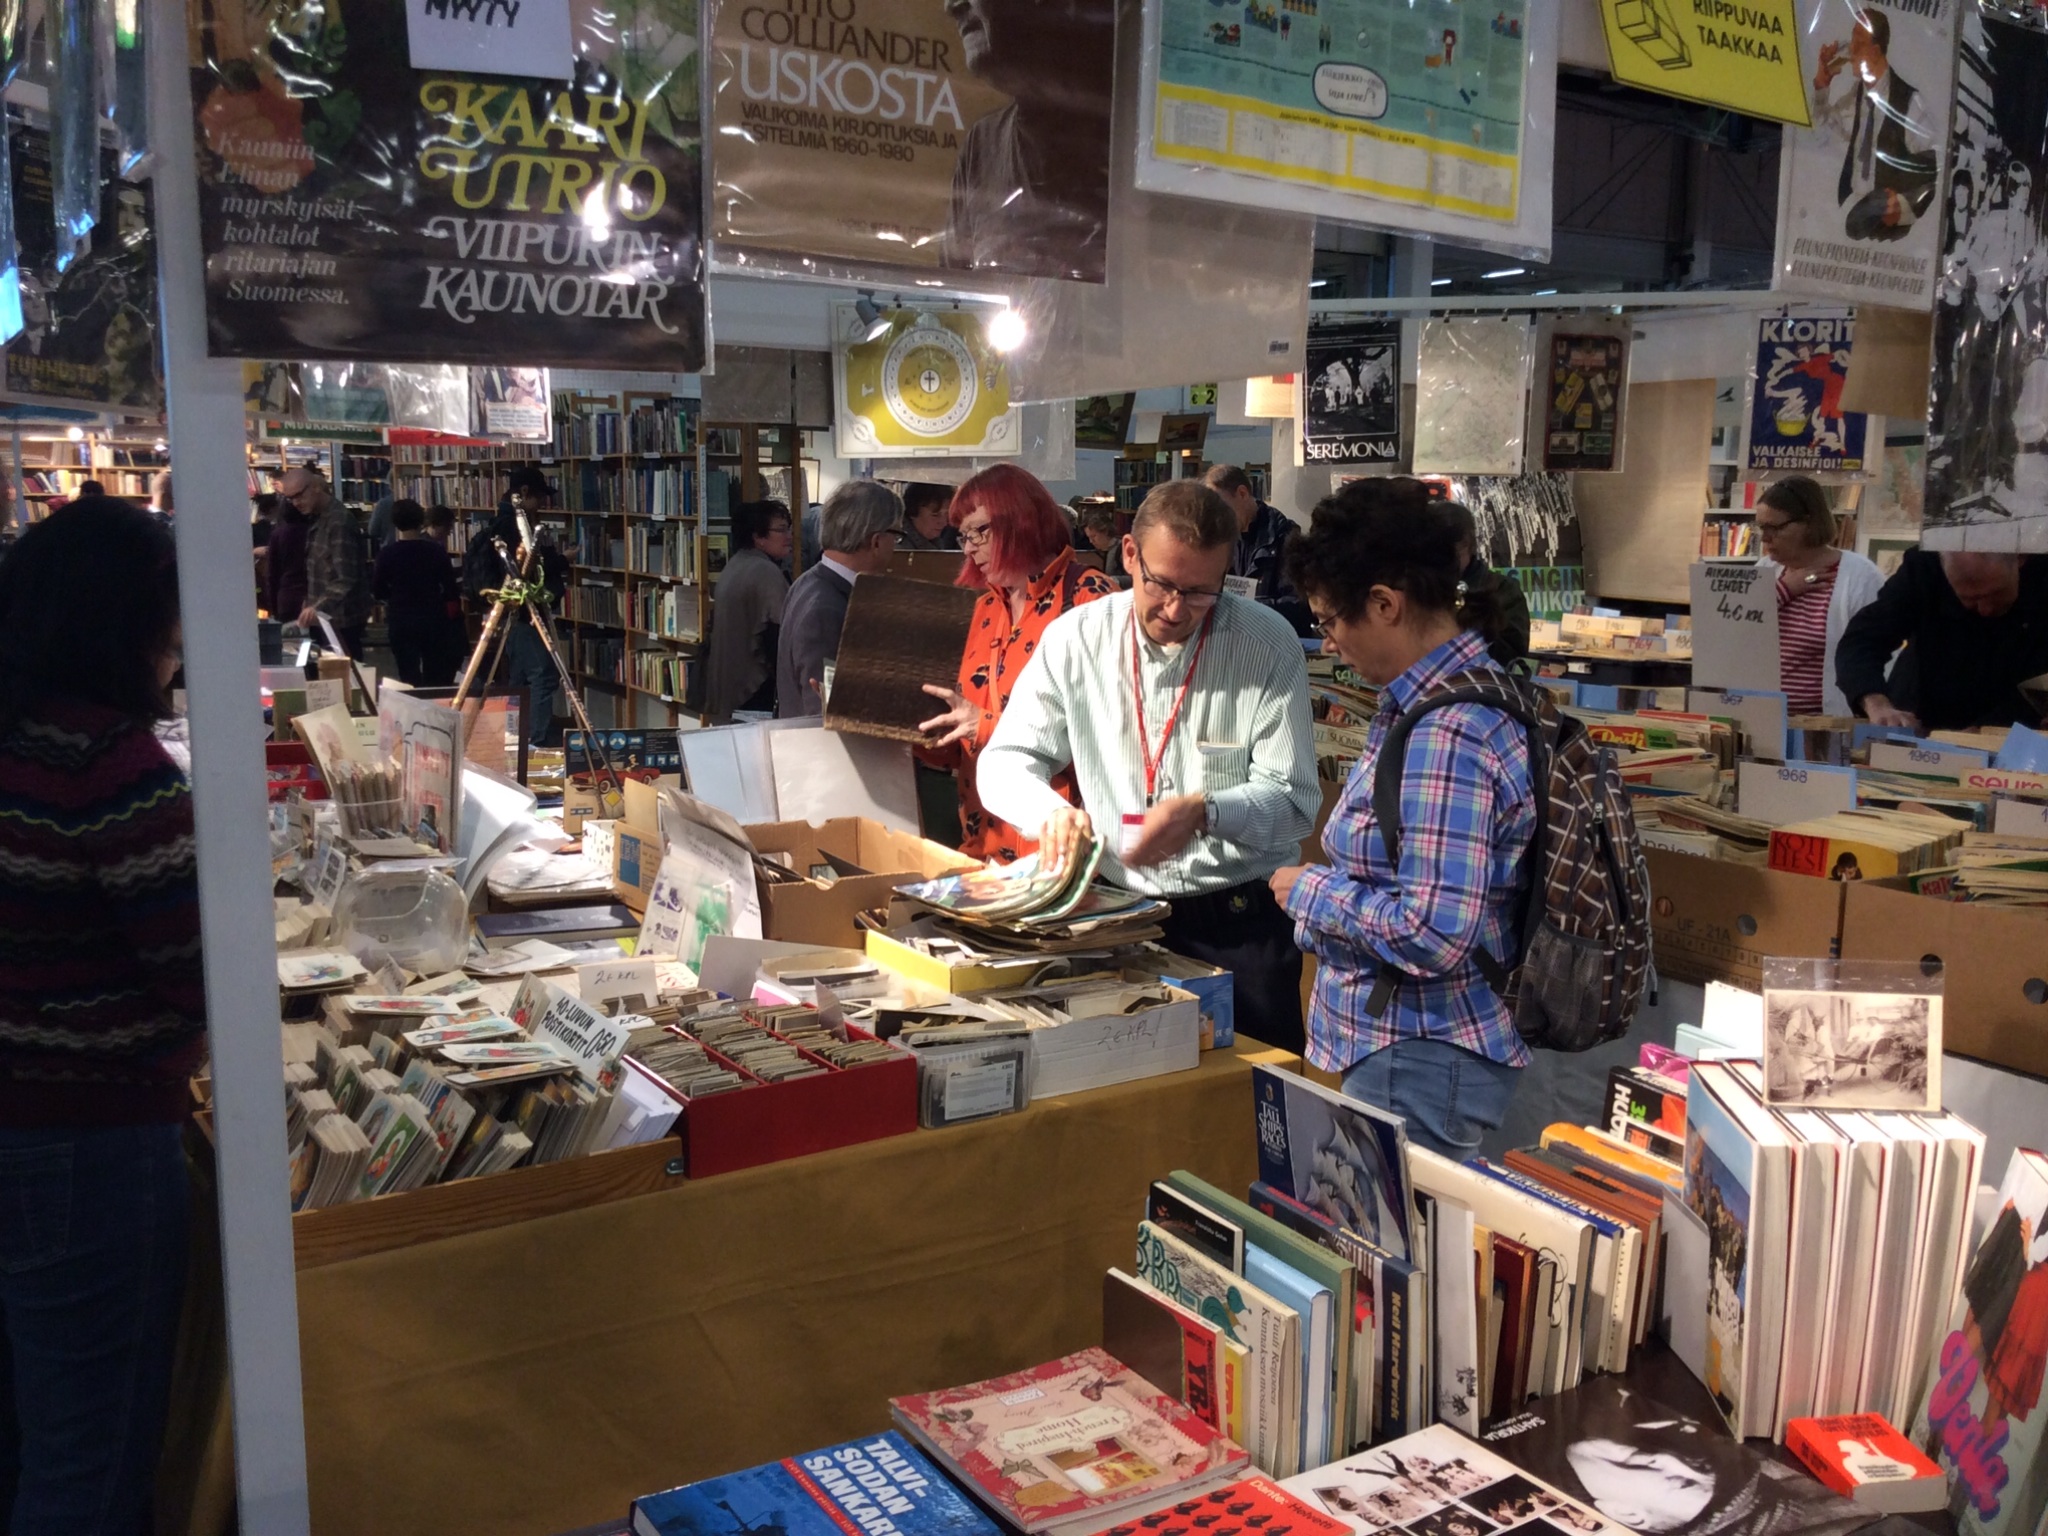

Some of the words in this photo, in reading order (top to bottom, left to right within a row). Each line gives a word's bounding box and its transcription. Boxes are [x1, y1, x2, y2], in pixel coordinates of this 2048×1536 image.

[741, 6, 952, 73] COLLIANDER
[1697, 25, 1783, 64] TAAKKAA
[740, 42, 965, 130] USKOSTA
[419, 79, 653, 164] KAARI
[741, 102, 829, 132] VALIKOIMA
[833, 116, 939, 148] KIRJOITUKSIA
[941, 131, 958, 149] JA
[219, 131, 316, 162] Kauniin
[831, 136, 915, 162] 1960-1980
[218, 161, 299, 189] Elinan
[419, 146, 667, 222] UTRIO
[220, 195, 355, 221] myrskyisät
[223, 221, 320, 248] kohtalot
[424, 215, 675, 285] VIIPURIN
[223, 250, 338, 278] ritariajan
[226, 278, 350, 306] Suomessa.
[419, 265, 680, 334] KAUNOTAR
[1306, 439, 1396, 461] SEREMONIA
[1751, 457, 1768, 469] JA
[1773, 456, 1842, 470] DESINFIOI!
[1752, 445, 1821, 459] VALKAISEE
[1710, 579, 1752, 594] LEHDET
[1776, 768, 1808, 784] 1968
[1908, 750, 1941, 765] 1969
[555, 995, 593, 1031] 40-LUVUN
[541, 1009, 588, 1055] POSTIKORTIT
[1390, 1291, 1402, 1329] Neil
[1259, 1306, 1271, 1374] Kannaksen
[1272, 1315, 1282, 1349] Tuuli
[1268, 1351, 1280, 1406] Reijonen
[1389, 1330, 1402, 1421] Hardwick
[1015, 1413, 1122, 1452] French-Inspired
[1035, 1415, 1082, 1435] Home
[833, 1447, 916, 1517] SODAN
[864, 1438, 927, 1498] TALVI-
[803, 1455, 906, 1536] SANKAR
[1287, 1502, 1335, 1530] Helvetti
